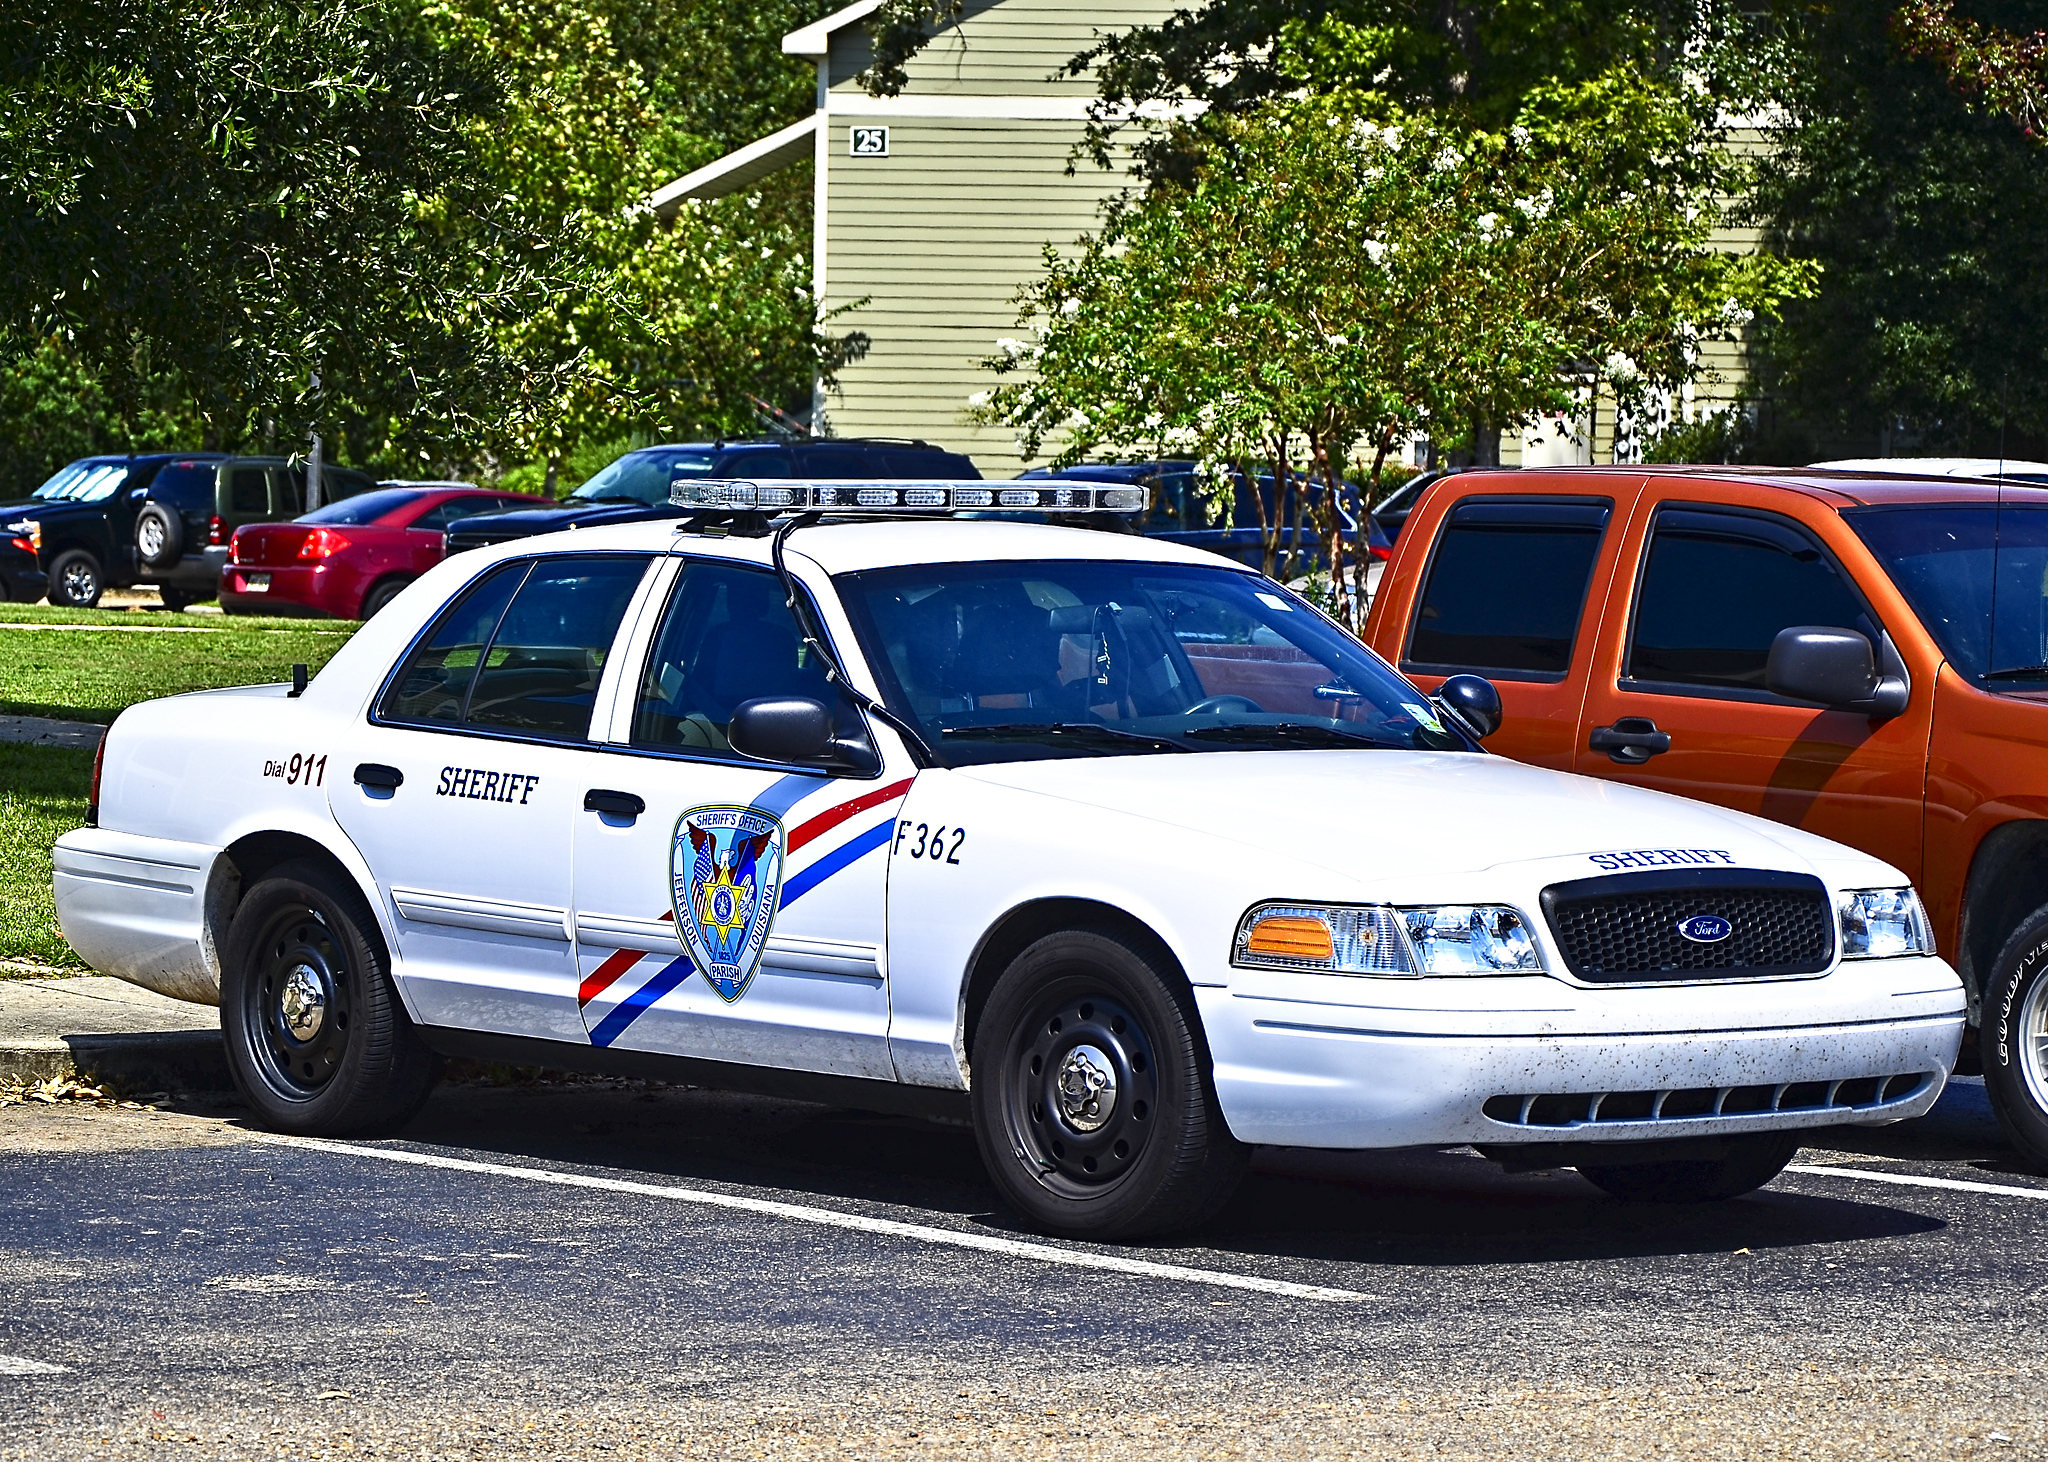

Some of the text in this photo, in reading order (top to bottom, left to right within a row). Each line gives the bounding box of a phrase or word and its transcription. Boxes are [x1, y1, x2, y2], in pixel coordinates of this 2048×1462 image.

[856, 130, 883, 152] 25
[263, 752, 328, 787] Dial 911
[436, 765, 539, 805] SHERIFF
[696, 813, 767, 834] SHERIFF'S OFFICE
[893, 820, 966, 866] F362
[1589, 849, 1736, 870] SHERIFF
[674, 872, 699, 946] JEFFERSON
[749, 884, 775, 952] LOUISIANA
[1694, 920, 1720, 936] Ford
[712, 965, 740, 980] PARISH
